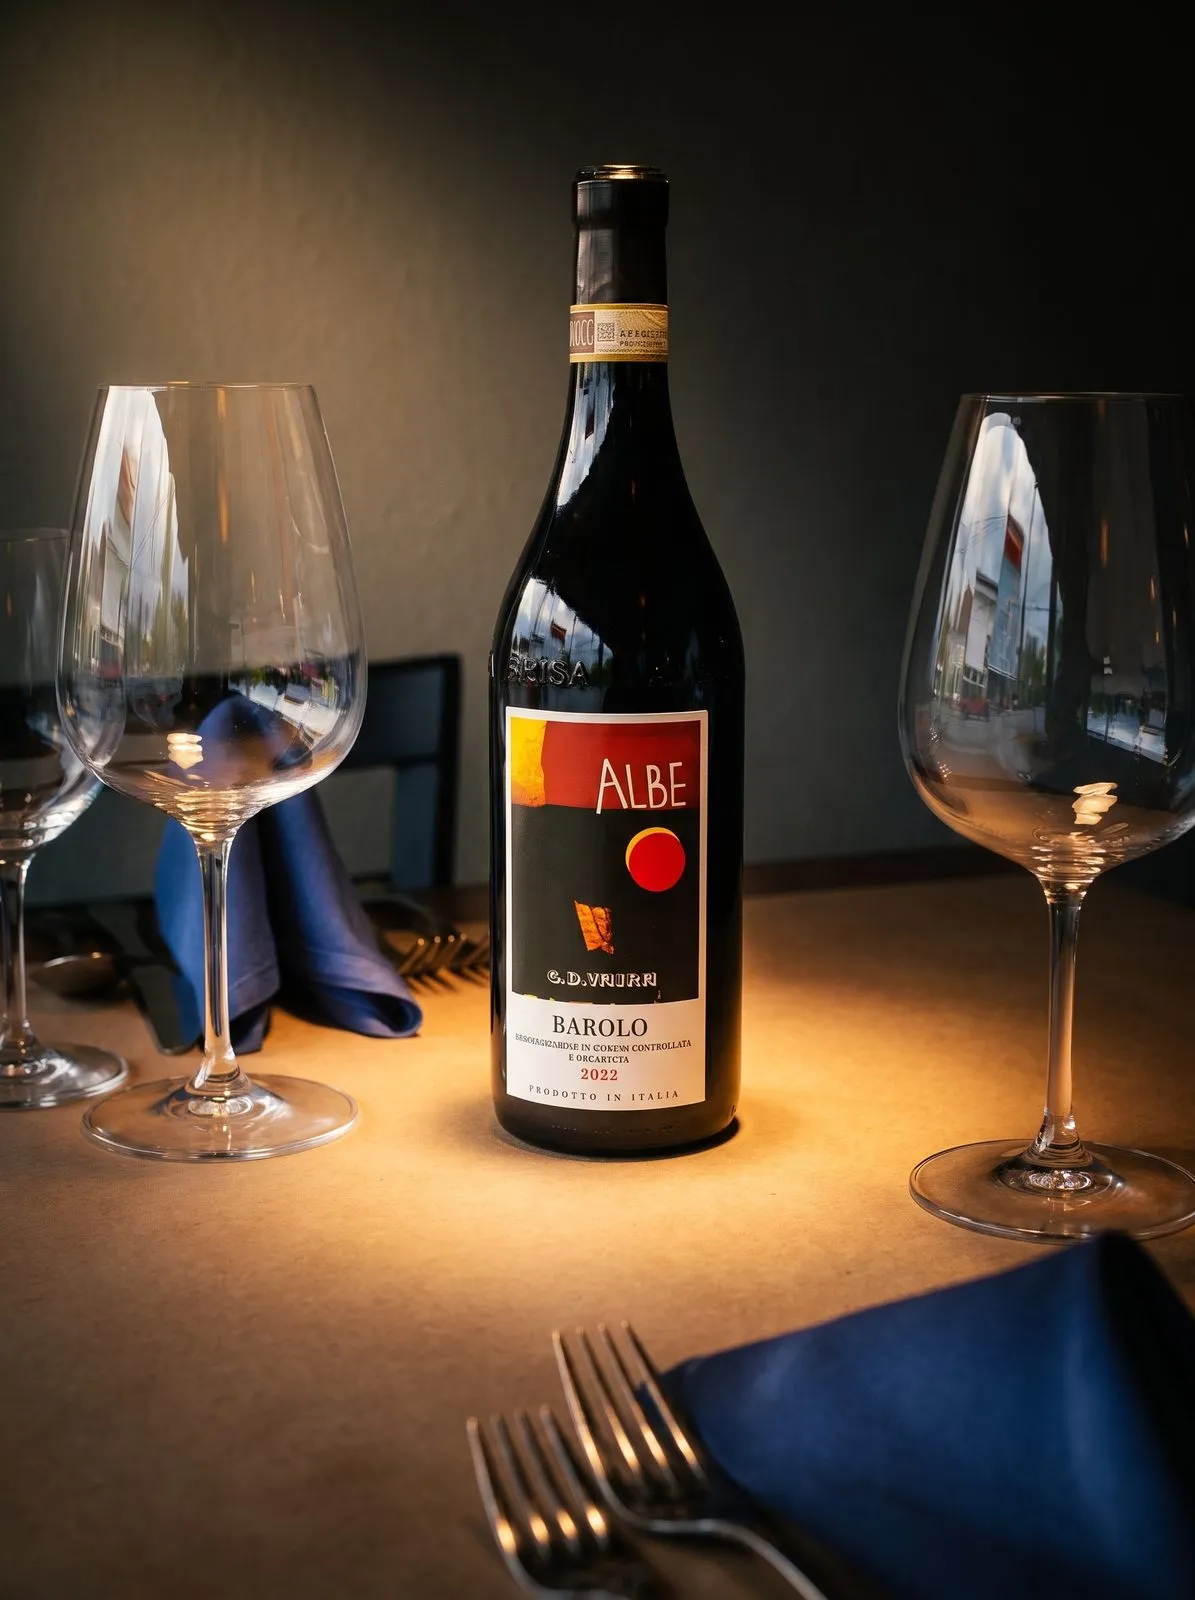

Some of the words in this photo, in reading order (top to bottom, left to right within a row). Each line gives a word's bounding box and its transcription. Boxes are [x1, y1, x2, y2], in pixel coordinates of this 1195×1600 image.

[596, 758, 686, 814] ALBE
[552, 1015, 648, 1037] BAROLO
[581, 1043, 591, 1051] IN
[631, 1039, 692, 1053] CONTROLLATA
[568, 1053, 575, 1061] E
[581, 1068, 618, 1081] 2022
[529, 1084, 597, 1101] PRODOTTO
[607, 1093, 621, 1101] IN
[631, 1090, 679, 1101] ITALIA
